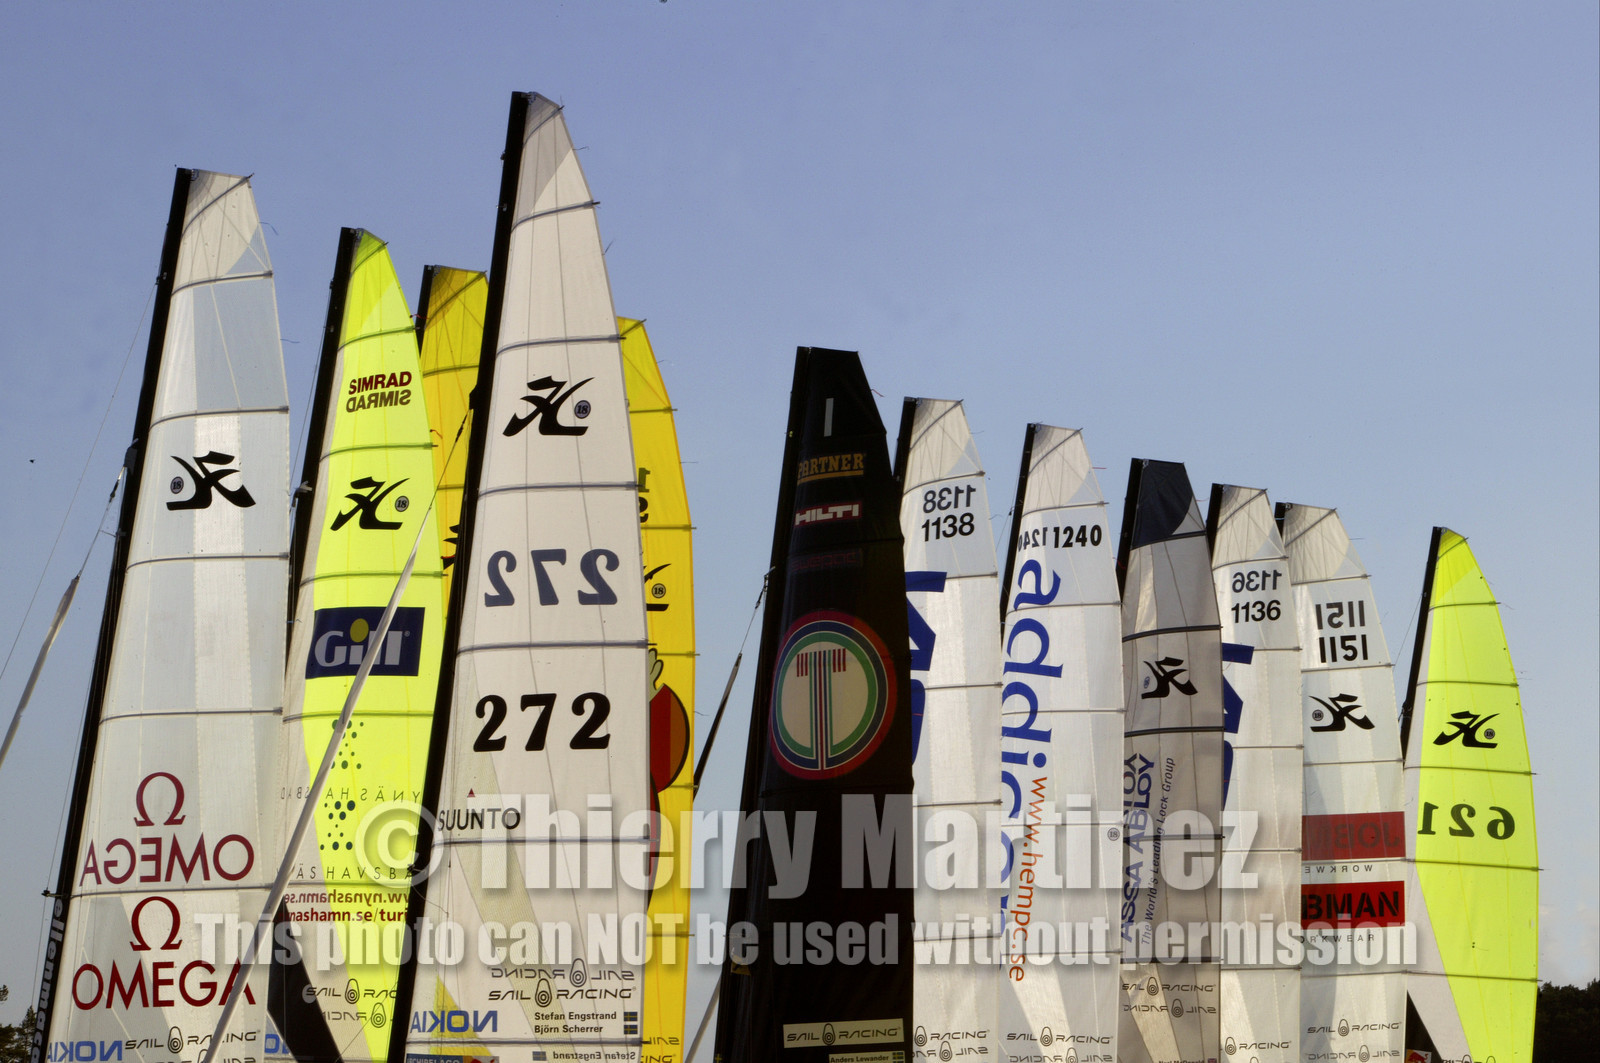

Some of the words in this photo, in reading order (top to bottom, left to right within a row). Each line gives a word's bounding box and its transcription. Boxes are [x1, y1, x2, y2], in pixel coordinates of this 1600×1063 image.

[348, 371, 412, 395] SIMRAD
[798, 453, 864, 477] PARTNER
[795, 504, 859, 525] HILTI
[921, 512, 974, 542] 1138
[1053, 525, 1101, 548] 1240
[1231, 599, 1281, 623] 1136
[315, 618, 402, 667] Gill
[1319, 635, 1369, 663] 1151
[473, 692, 611, 752] 272
[1161, 757, 1175, 794] Group
[1125, 753, 1155, 855] ABLOY
[438, 807, 521, 831] SUUNTO
[1009, 777, 1047, 981] www.hempc.se
[1121, 861, 1143, 943] ASSA
[71, 958, 256, 1010] OMEGA
[306, 986, 341, 997] SAIL
[488, 990, 531, 1001] SAIL
[556, 988, 632, 1000] RACING
[1122, 983, 1145, 991] SAIL
[1161, 984, 1214, 992] RACING
[534, 1011, 567, 1021] Stefan
[568, 1011, 617, 1023] Engstrand
[1307, 1026, 1336, 1034] SAIL
[1351, 1022, 1400, 1032] RACING
[125, 1038, 164, 1050] SAIL
[187, 1031, 257, 1046] RAING
[534, 1024, 560, 1034] Björn
[563, 1024, 603, 1034] Scherrer
[786, 1033, 820, 1042] SAIL
[838, 1028, 898, 1040] RACING
[930, 1031, 987, 1041] RACING
[1007, 1032, 1037, 1041] SAIL
[1056, 1035, 1111, 1045] RACING
[1239, 1041, 1290, 1050] RACING
